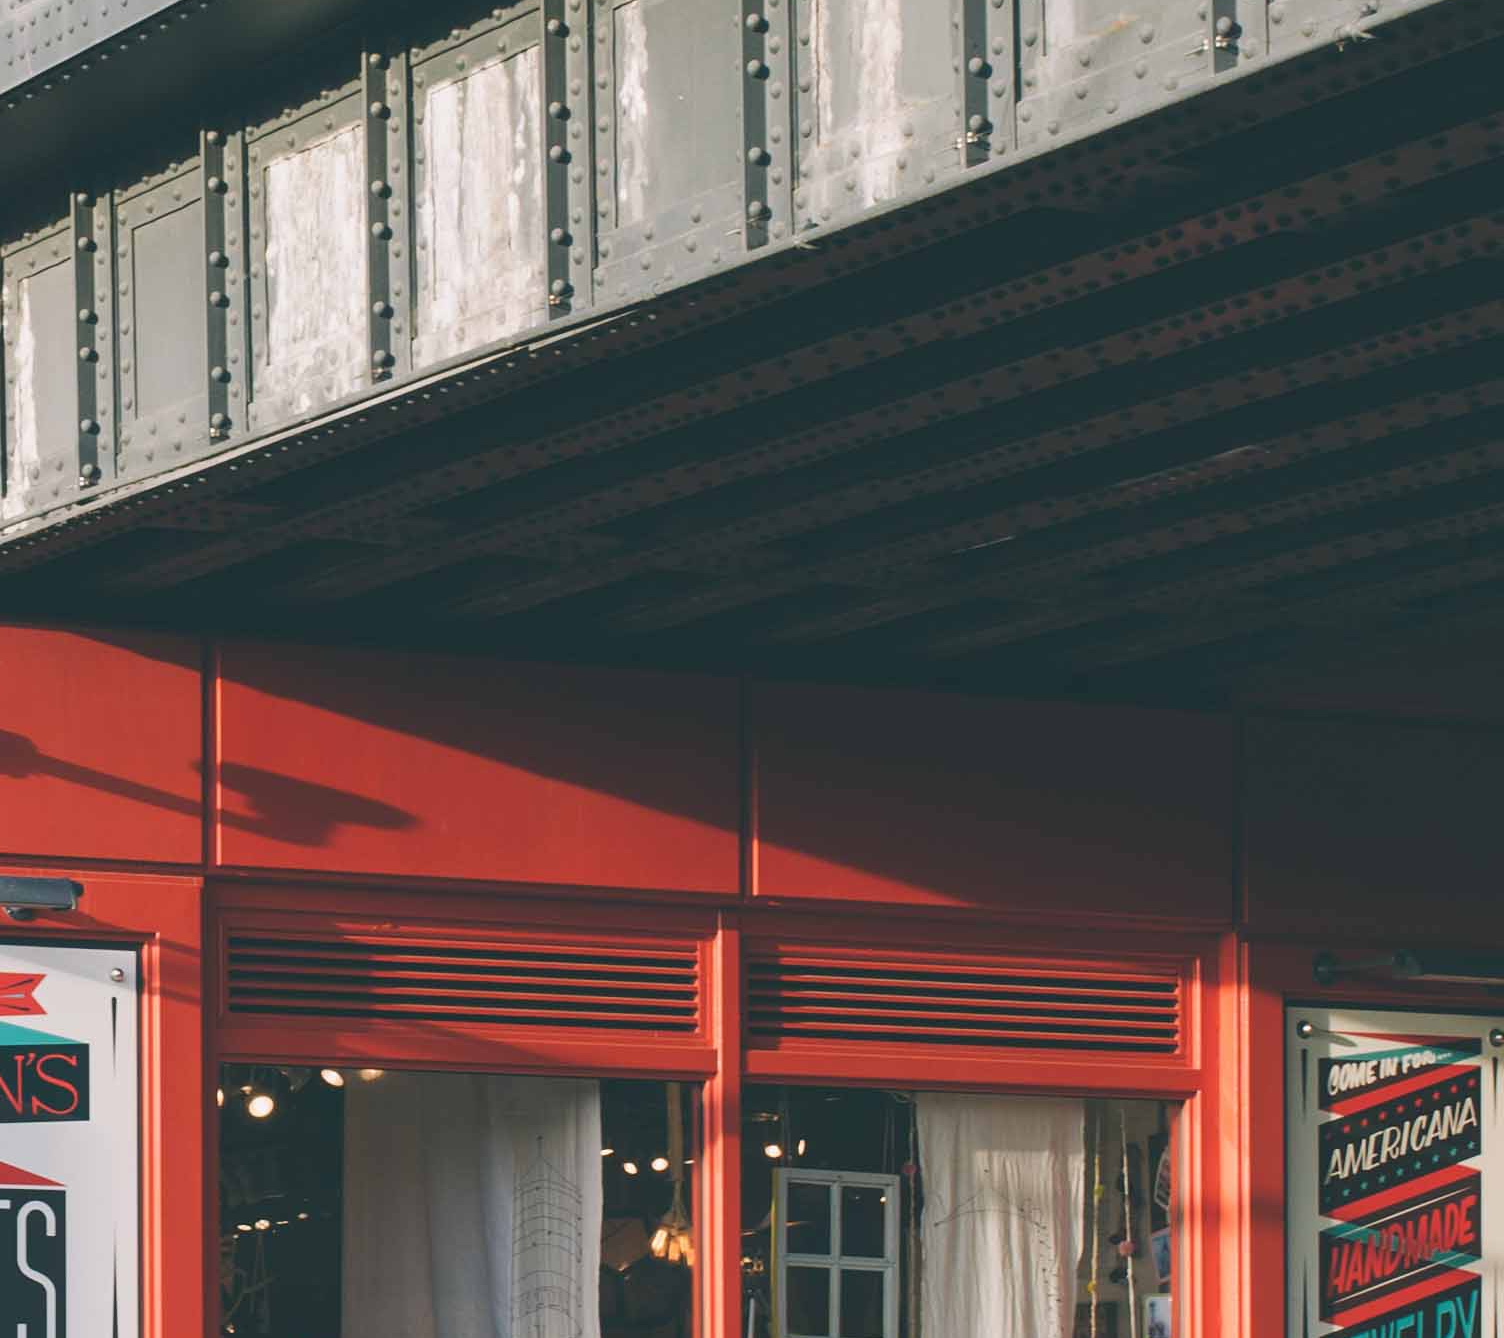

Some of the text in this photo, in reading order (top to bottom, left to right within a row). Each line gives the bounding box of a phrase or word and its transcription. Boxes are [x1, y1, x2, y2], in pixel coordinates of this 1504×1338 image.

[1327, 1060, 1377, 1096] COME
[1379, 1057, 1399, 1080] IN
[1323, 1096, 1478, 1185] AMERICANA
[1327, 1194, 1478, 1297] HANDMADE
